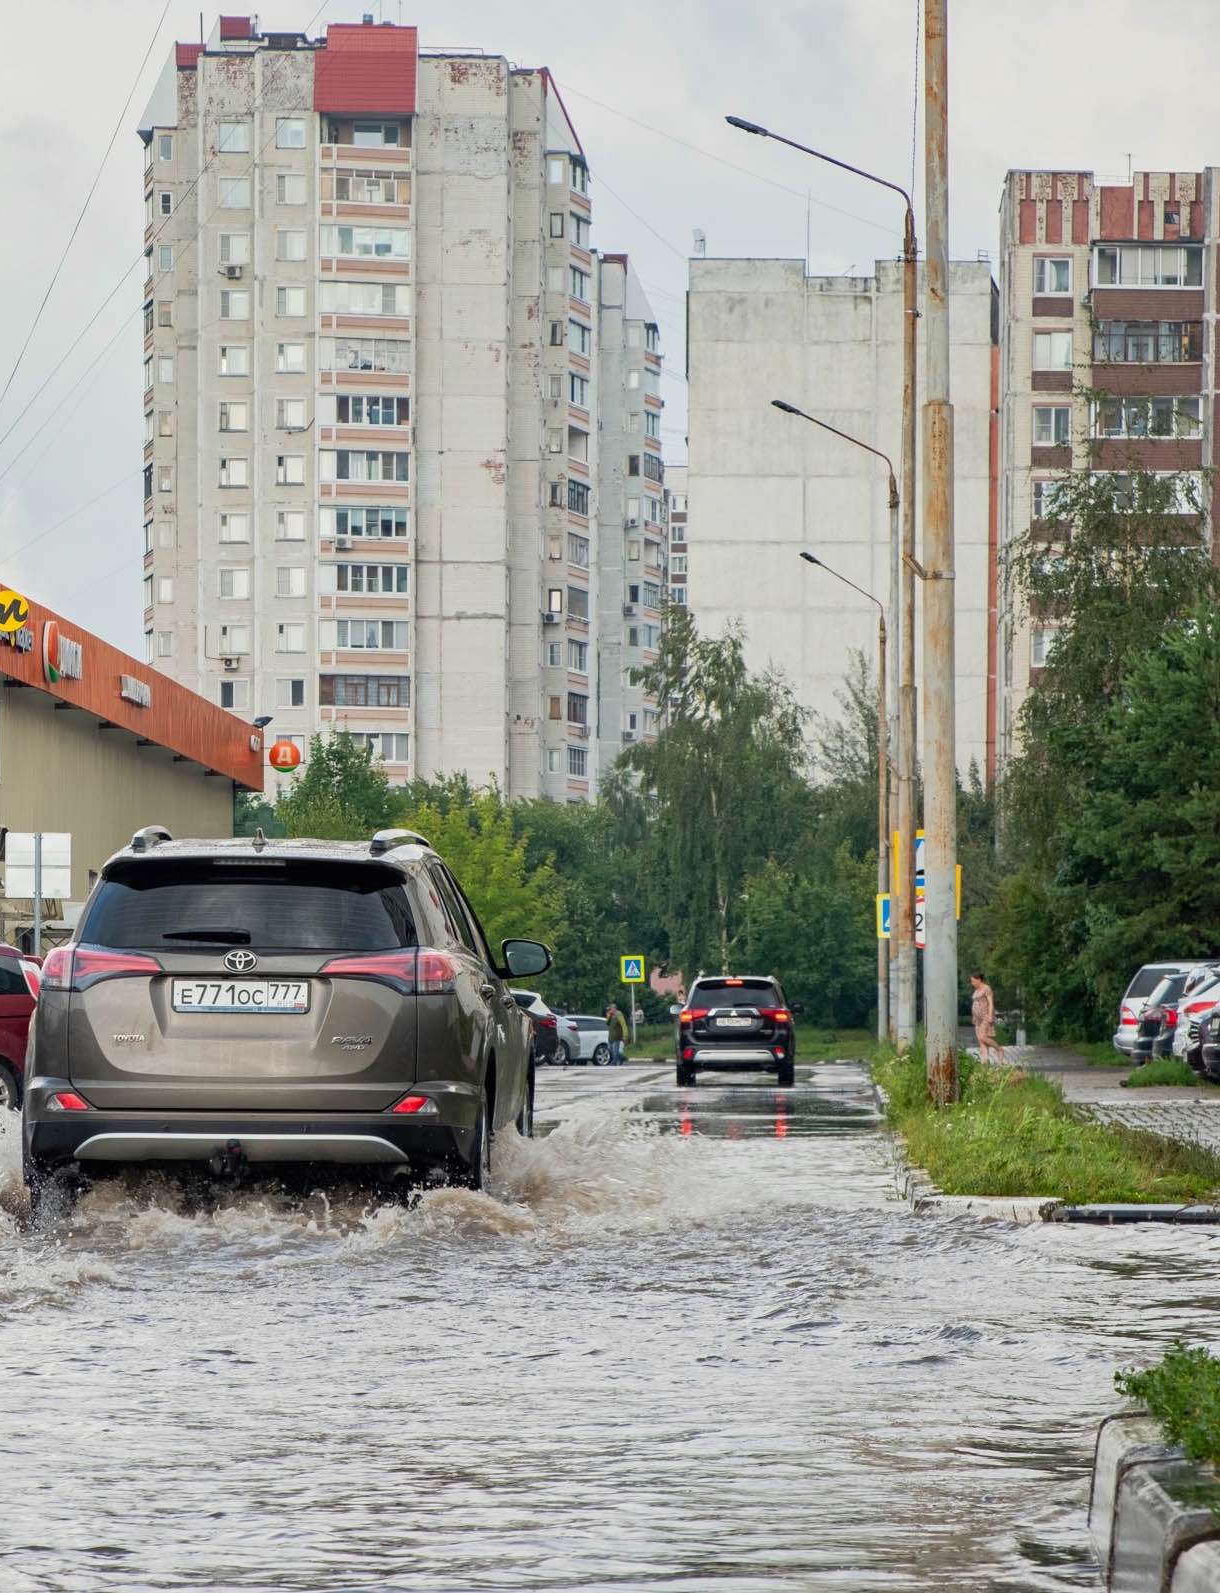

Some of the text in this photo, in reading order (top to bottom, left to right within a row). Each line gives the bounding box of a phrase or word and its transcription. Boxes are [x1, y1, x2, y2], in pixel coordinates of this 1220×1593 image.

[181, 984, 302, 1005] Е771ОС 777
[112, 1034, 145, 1042] TOYOTA
